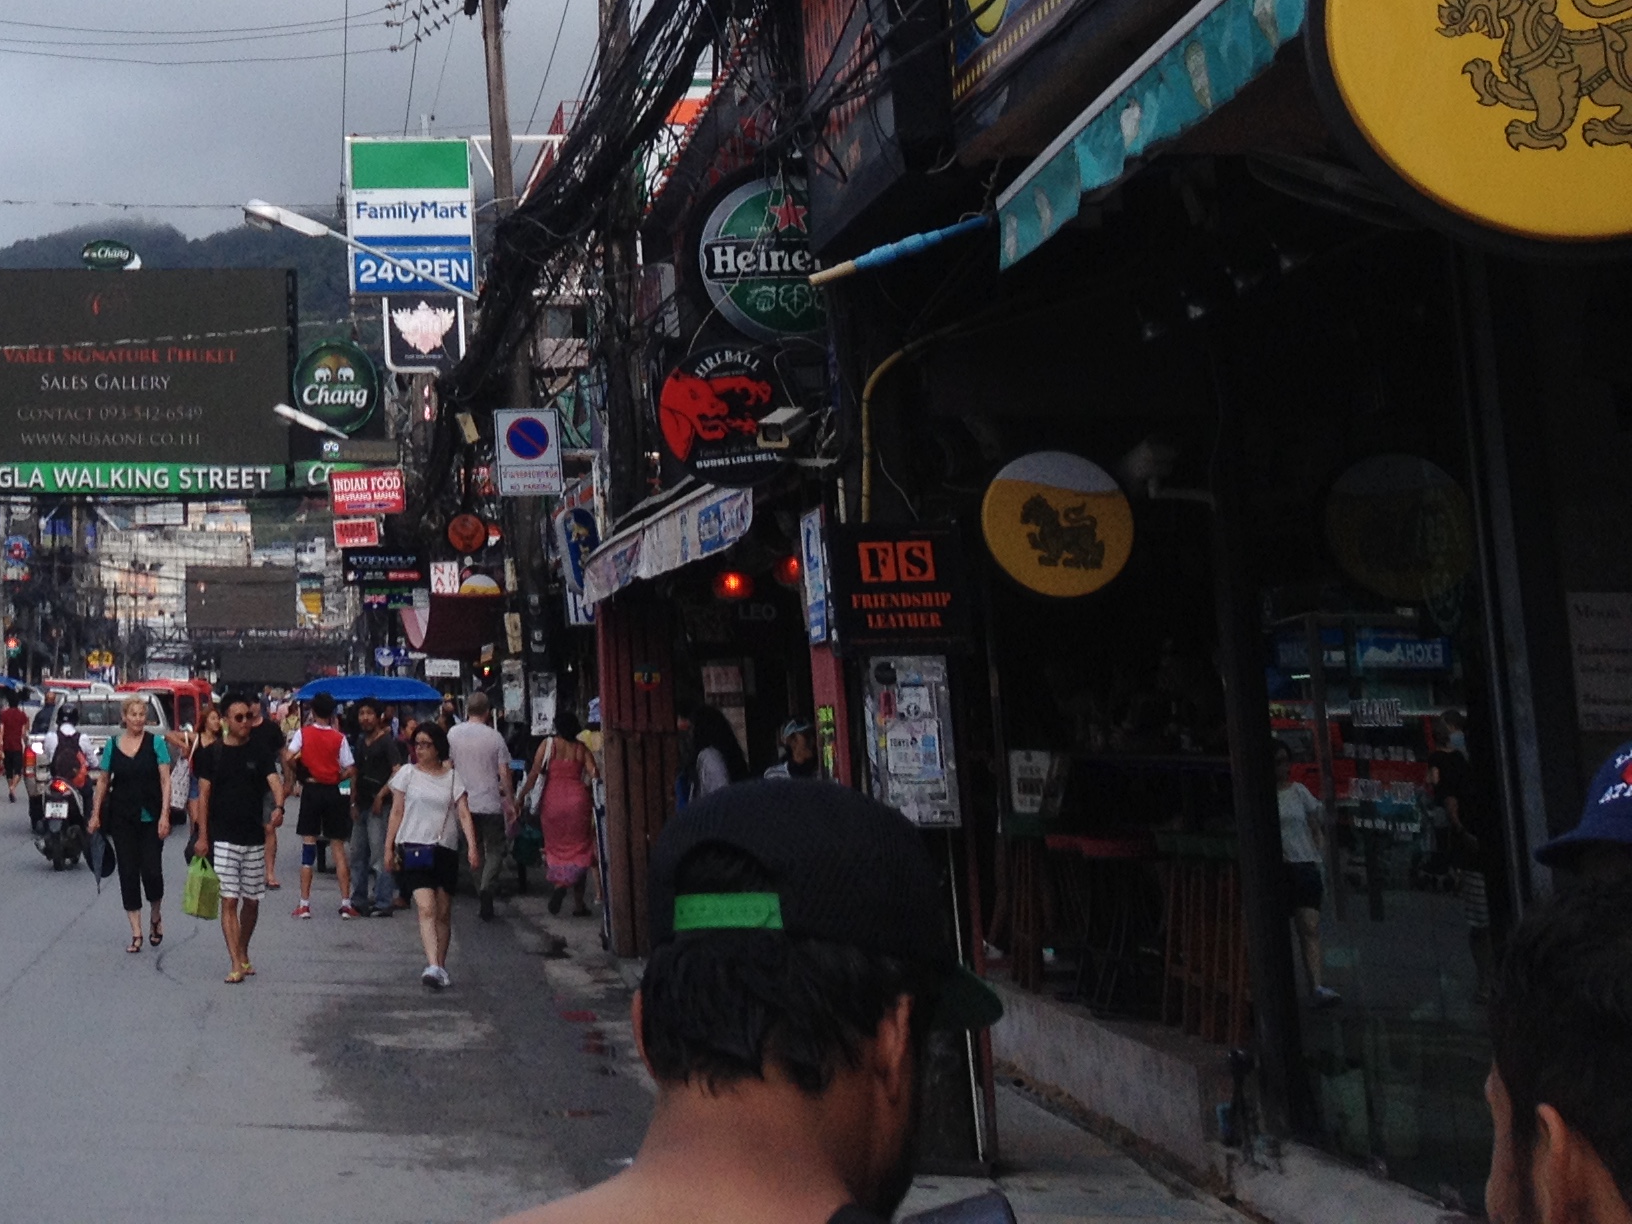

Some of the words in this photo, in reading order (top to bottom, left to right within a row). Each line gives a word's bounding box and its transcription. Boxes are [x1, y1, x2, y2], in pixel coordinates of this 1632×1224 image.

[356, 201, 467, 223] FamilyMart
[98, 247, 130, 261] Chang
[712, 245, 821, 275] Heine
[62, 347, 160, 363] SIGNATURE
[167, 347, 237, 363] PHUKET
[695, 350, 760, 378] FIREBALL
[302, 383, 368, 408] Chang
[696, 458, 730, 469] BURNS
[731, 455, 754, 466] LIKE
[755, 452, 780, 462] HELL
[53, 466, 170, 490] WALKING
[179, 466, 271, 490] STREET
[333, 477, 368, 492] INDIAN
[371, 476, 401, 491] FOOD
[850, 592, 953, 609] FRIENDSHIP
[739, 602, 777, 621] LEO
[866, 612, 944, 629] LEATHER
